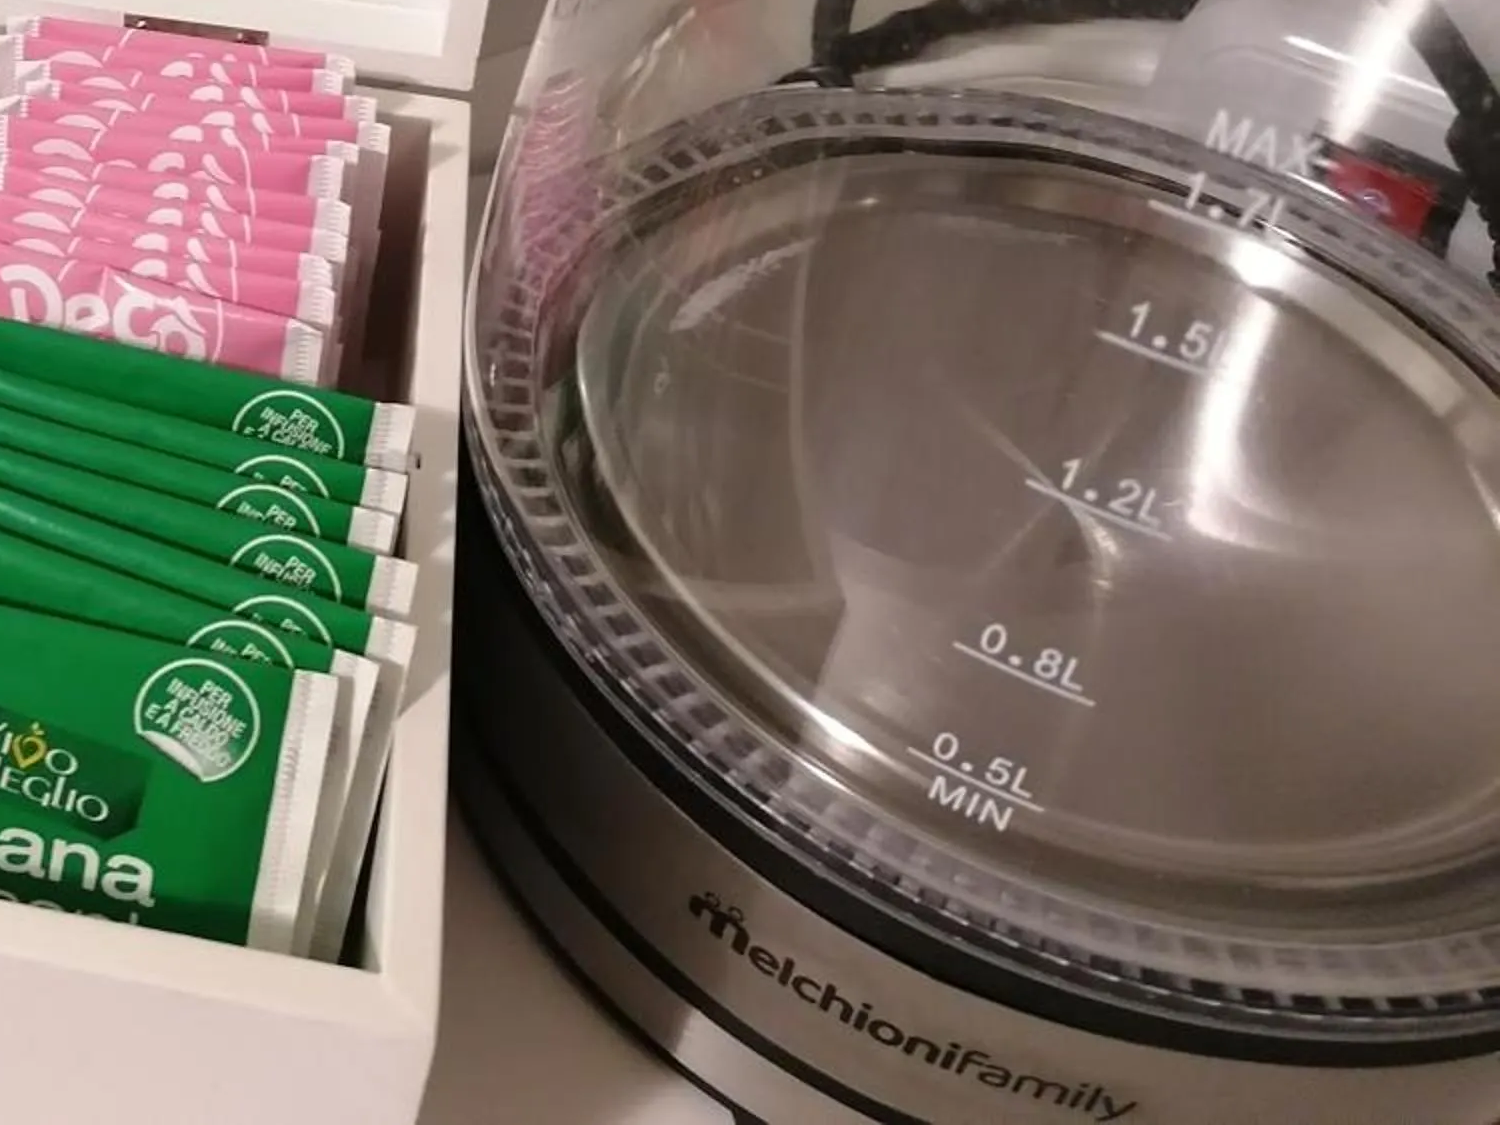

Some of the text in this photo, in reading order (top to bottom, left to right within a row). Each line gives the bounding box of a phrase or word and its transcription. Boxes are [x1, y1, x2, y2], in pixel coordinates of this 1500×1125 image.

[1204, 108, 1325, 177] MAX
[1060, 457, 1162, 528] 1.2L
[980, 622, 1084, 694] 0.8L
[199, 679, 233, 709] PER
[932, 731, 1033, 800] 0.5L
[927, 774, 1015, 833] MIN
